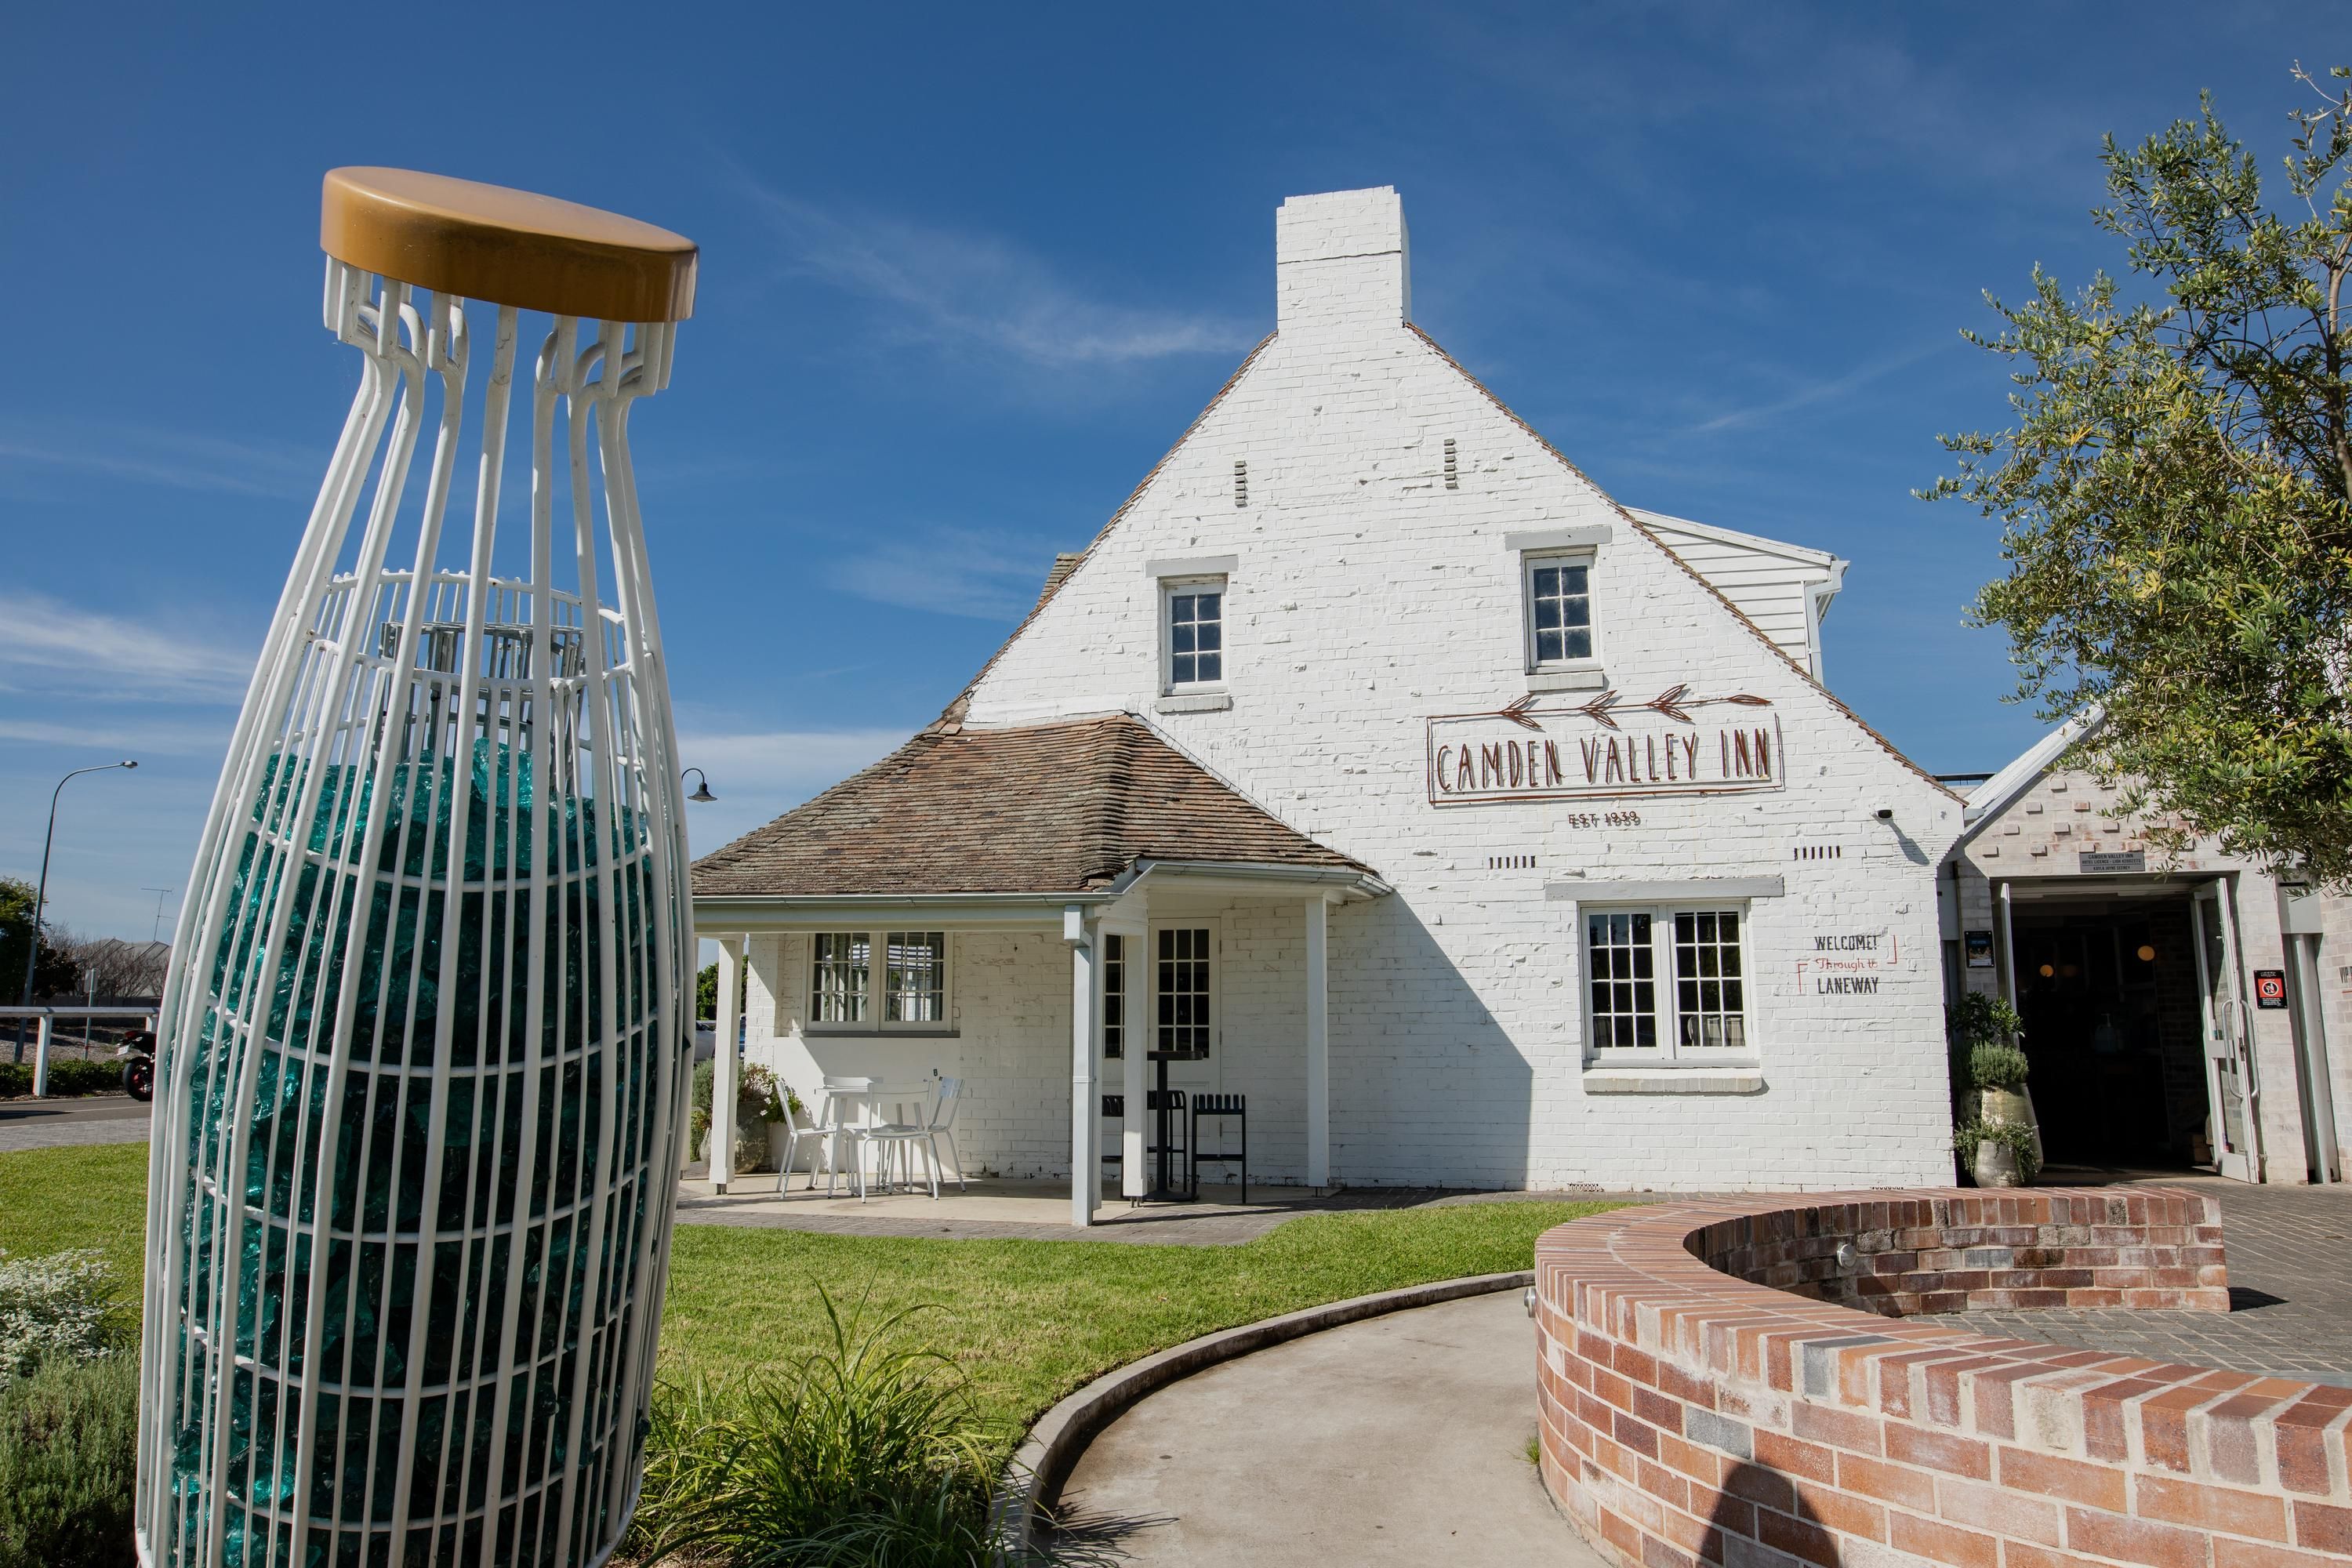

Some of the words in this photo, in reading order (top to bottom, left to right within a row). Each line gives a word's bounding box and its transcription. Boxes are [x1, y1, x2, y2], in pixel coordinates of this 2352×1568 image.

[1437, 739, 1560, 790] CAMDEN
[1580, 731, 1696, 784] VALLEY
[1720, 728, 1769, 778] INN
[1568, 813, 1596, 824] EST
[1604, 811, 1645, 823] 1939
[1815, 935, 1878, 951] WELCOME!
[1816, 958, 1864, 972] Through
[1867, 958, 1878, 968] to
[1817, 977, 1878, 994] LANEWAY
